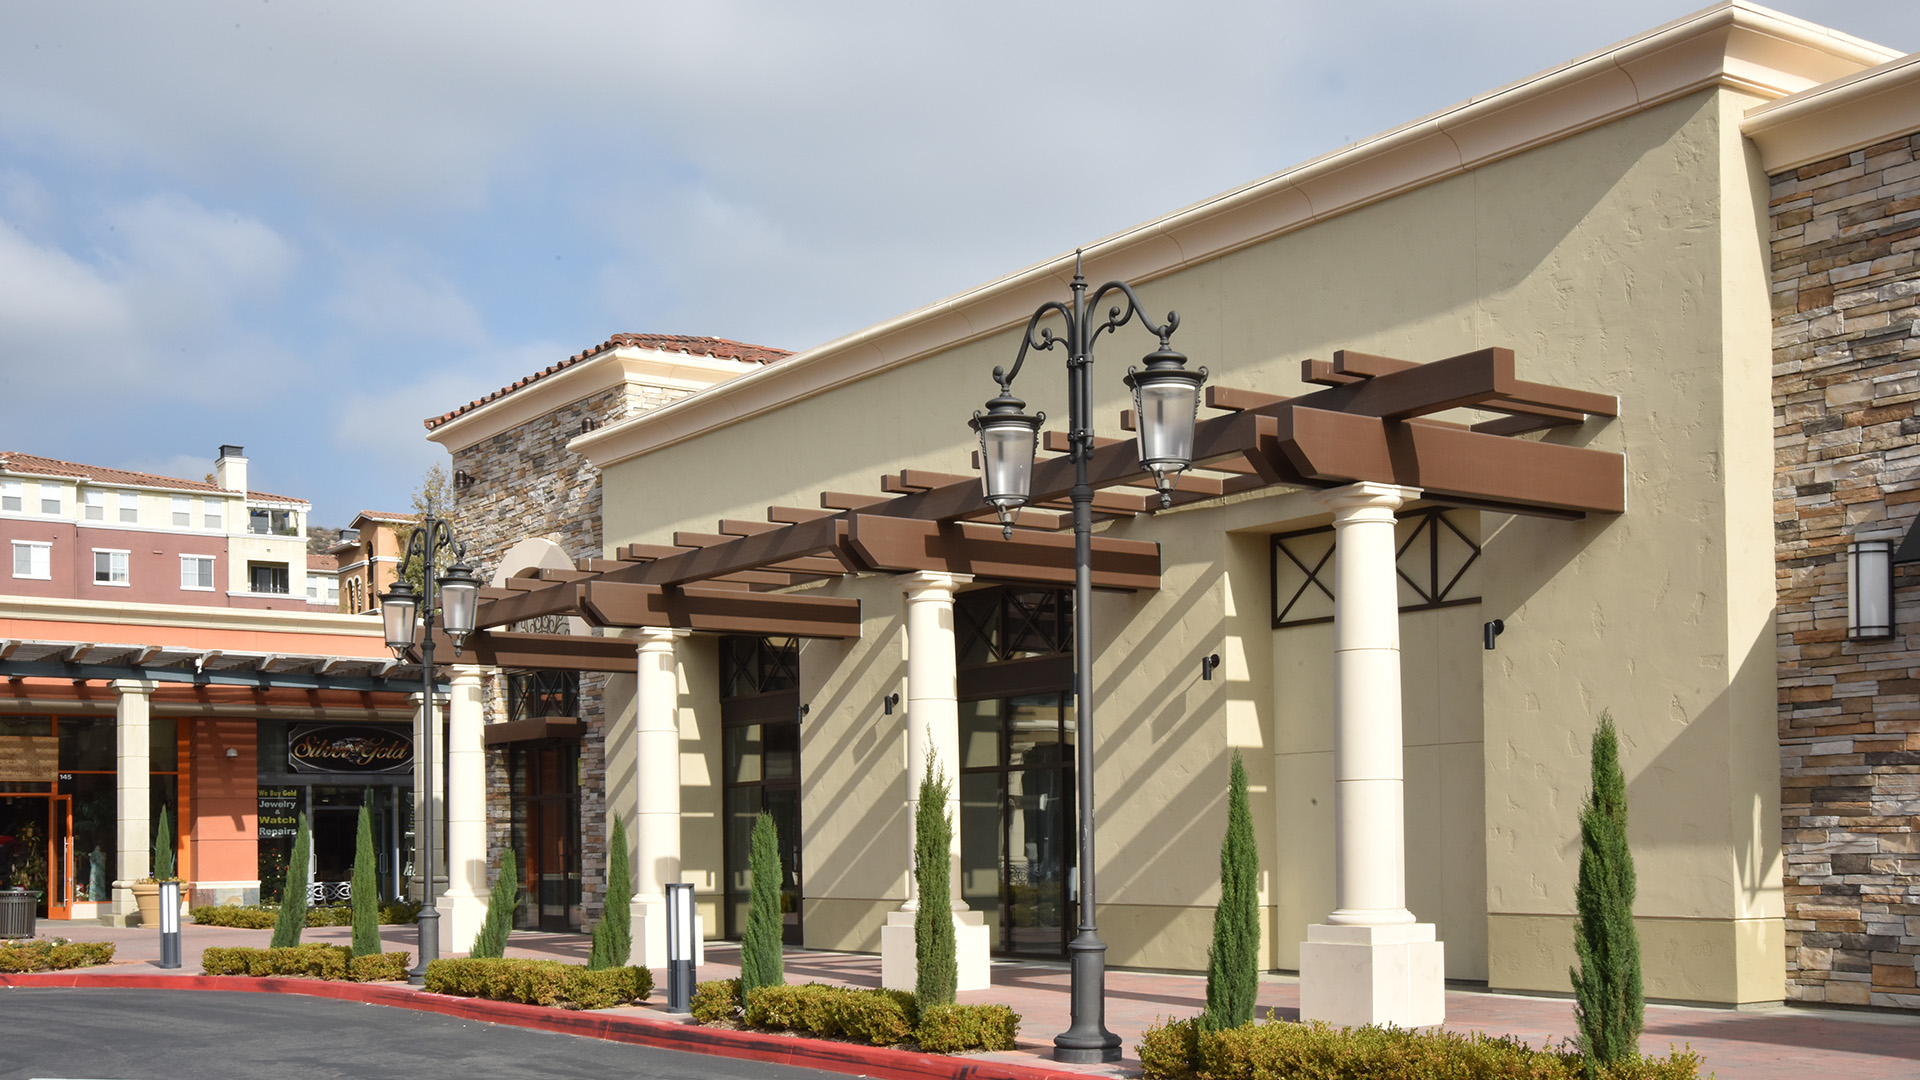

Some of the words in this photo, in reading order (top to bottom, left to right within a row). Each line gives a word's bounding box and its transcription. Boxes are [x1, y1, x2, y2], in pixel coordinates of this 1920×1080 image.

[294, 735, 351, 759] Silver
[356, 736, 410, 766] Gold
[258, 789, 268, 797] We
[270, 789, 281, 798] Buy
[283, 789, 297, 797] Gold
[258, 800, 296, 810] Jewelry
[258, 816, 297, 824] Watch
[258, 827, 297, 837] Repairs
